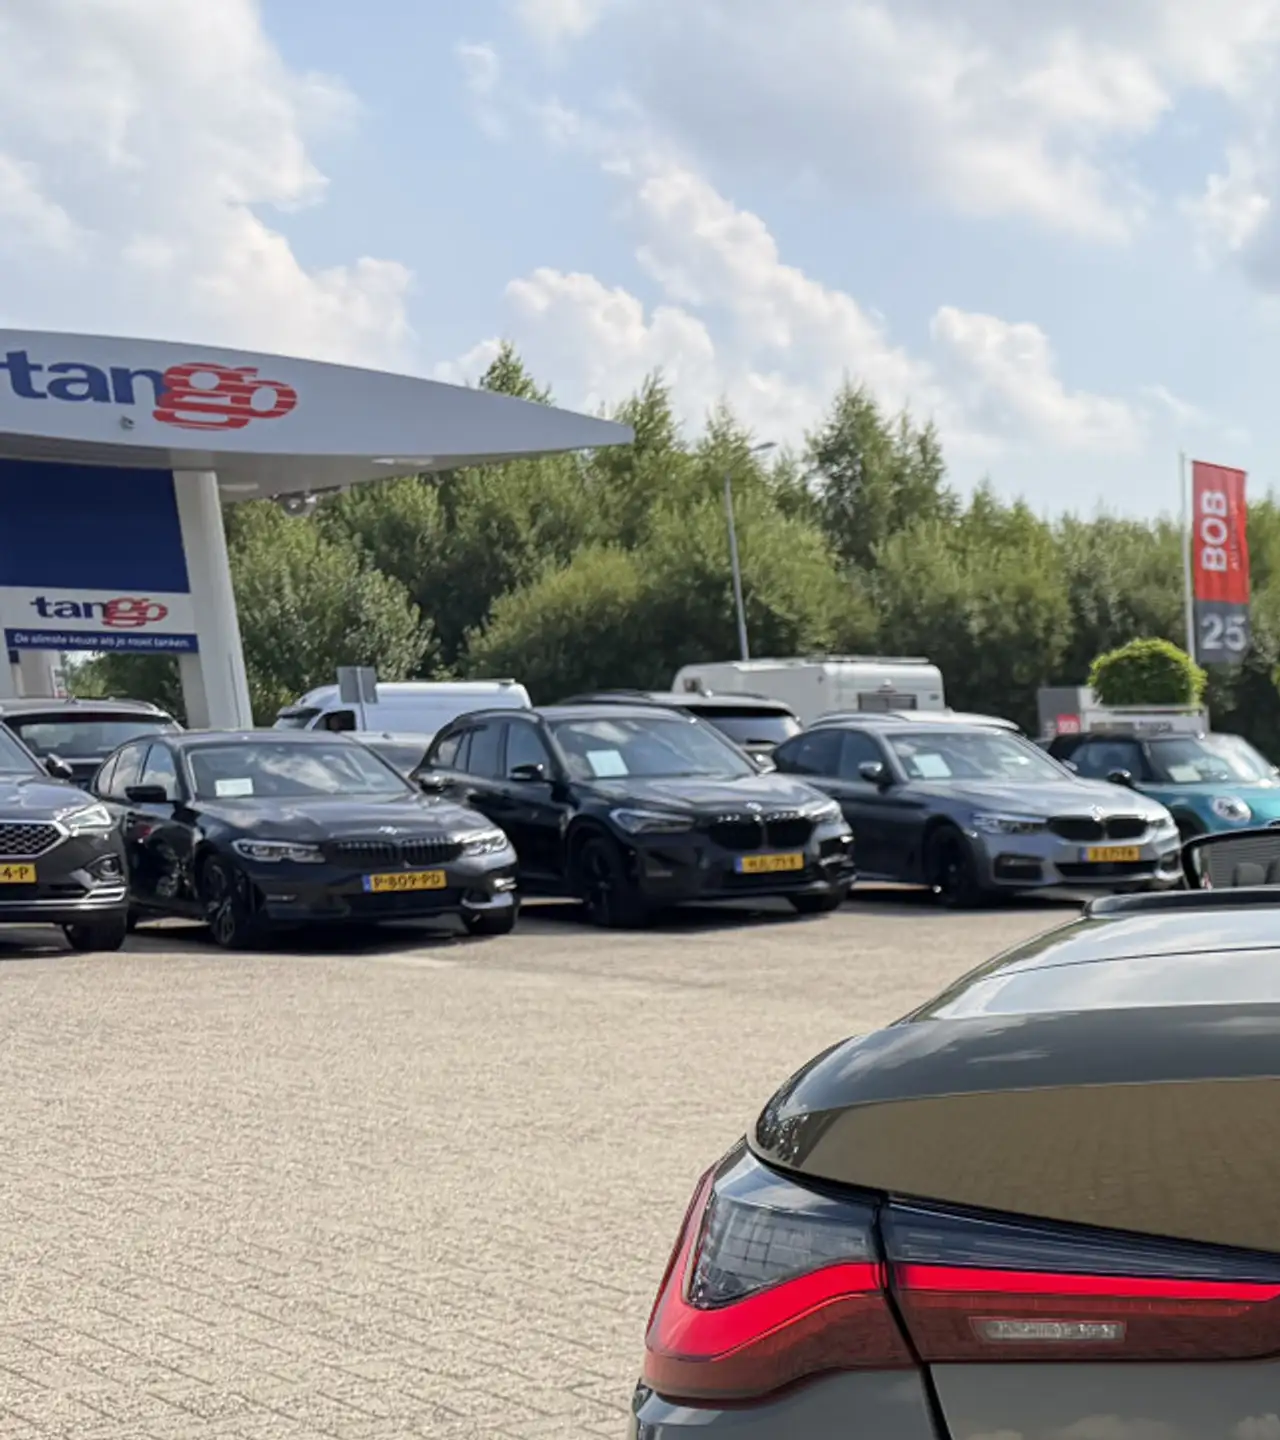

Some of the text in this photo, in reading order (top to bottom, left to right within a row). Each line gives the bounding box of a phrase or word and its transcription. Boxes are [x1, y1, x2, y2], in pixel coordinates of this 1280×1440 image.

[0, 350, 297, 431] tango
[1201, 490, 1228, 571] BOB
[30, 596, 168, 628] tango
[14, 632, 28, 643] De
[69, 634, 98, 645] keuze
[1201, 613, 1246, 651] 25
